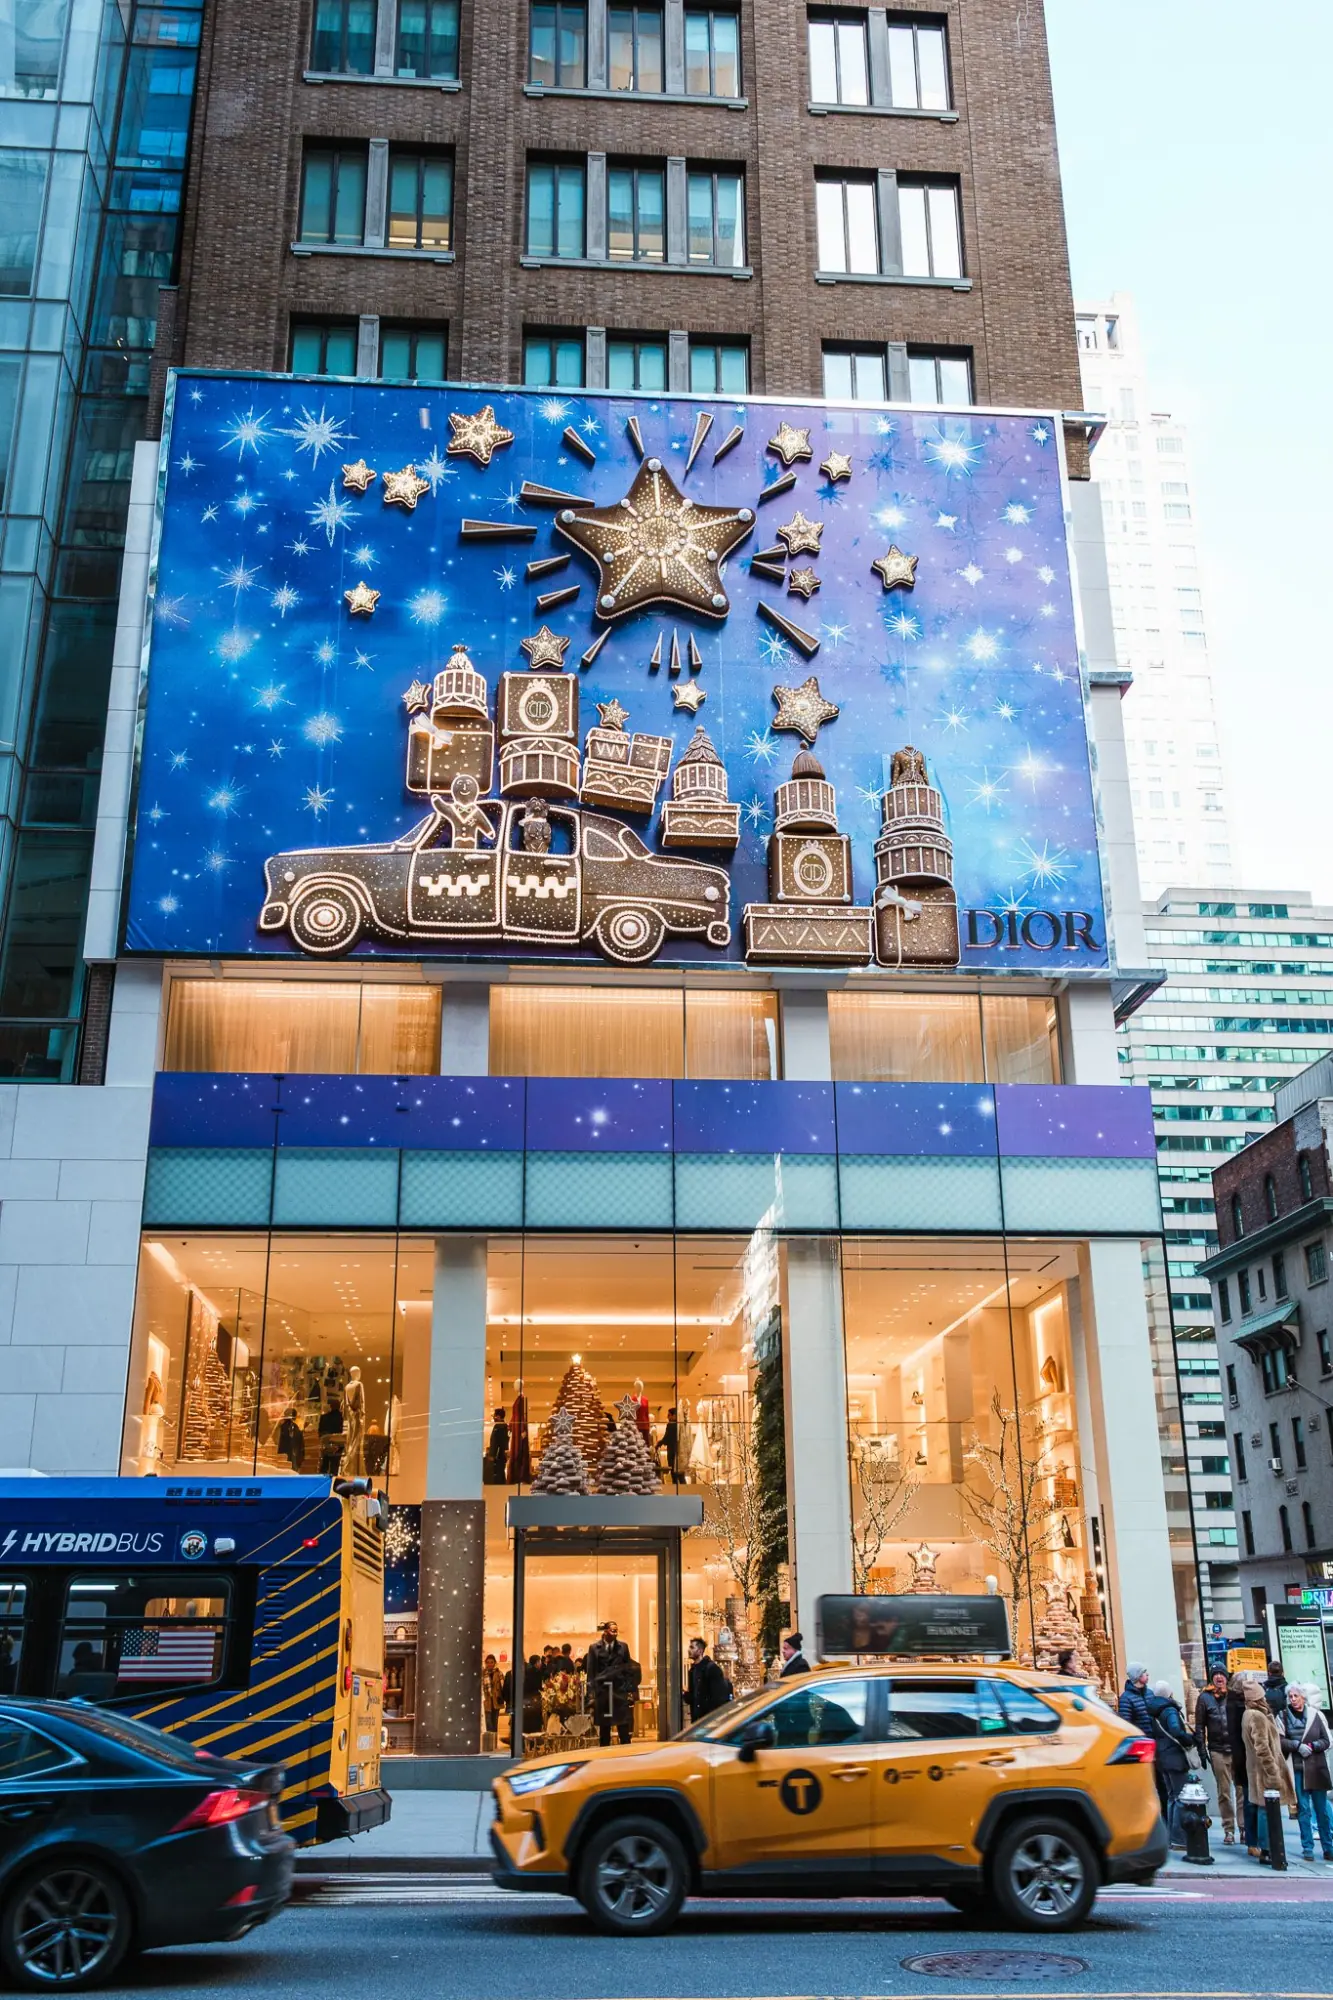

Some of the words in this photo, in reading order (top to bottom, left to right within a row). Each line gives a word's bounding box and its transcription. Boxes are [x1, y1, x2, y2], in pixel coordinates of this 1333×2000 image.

[963, 909, 1102, 951] DIOR
[21, 1532, 164, 1553] HYBRIDBUS
[787, 1777, 813, 1810] T
